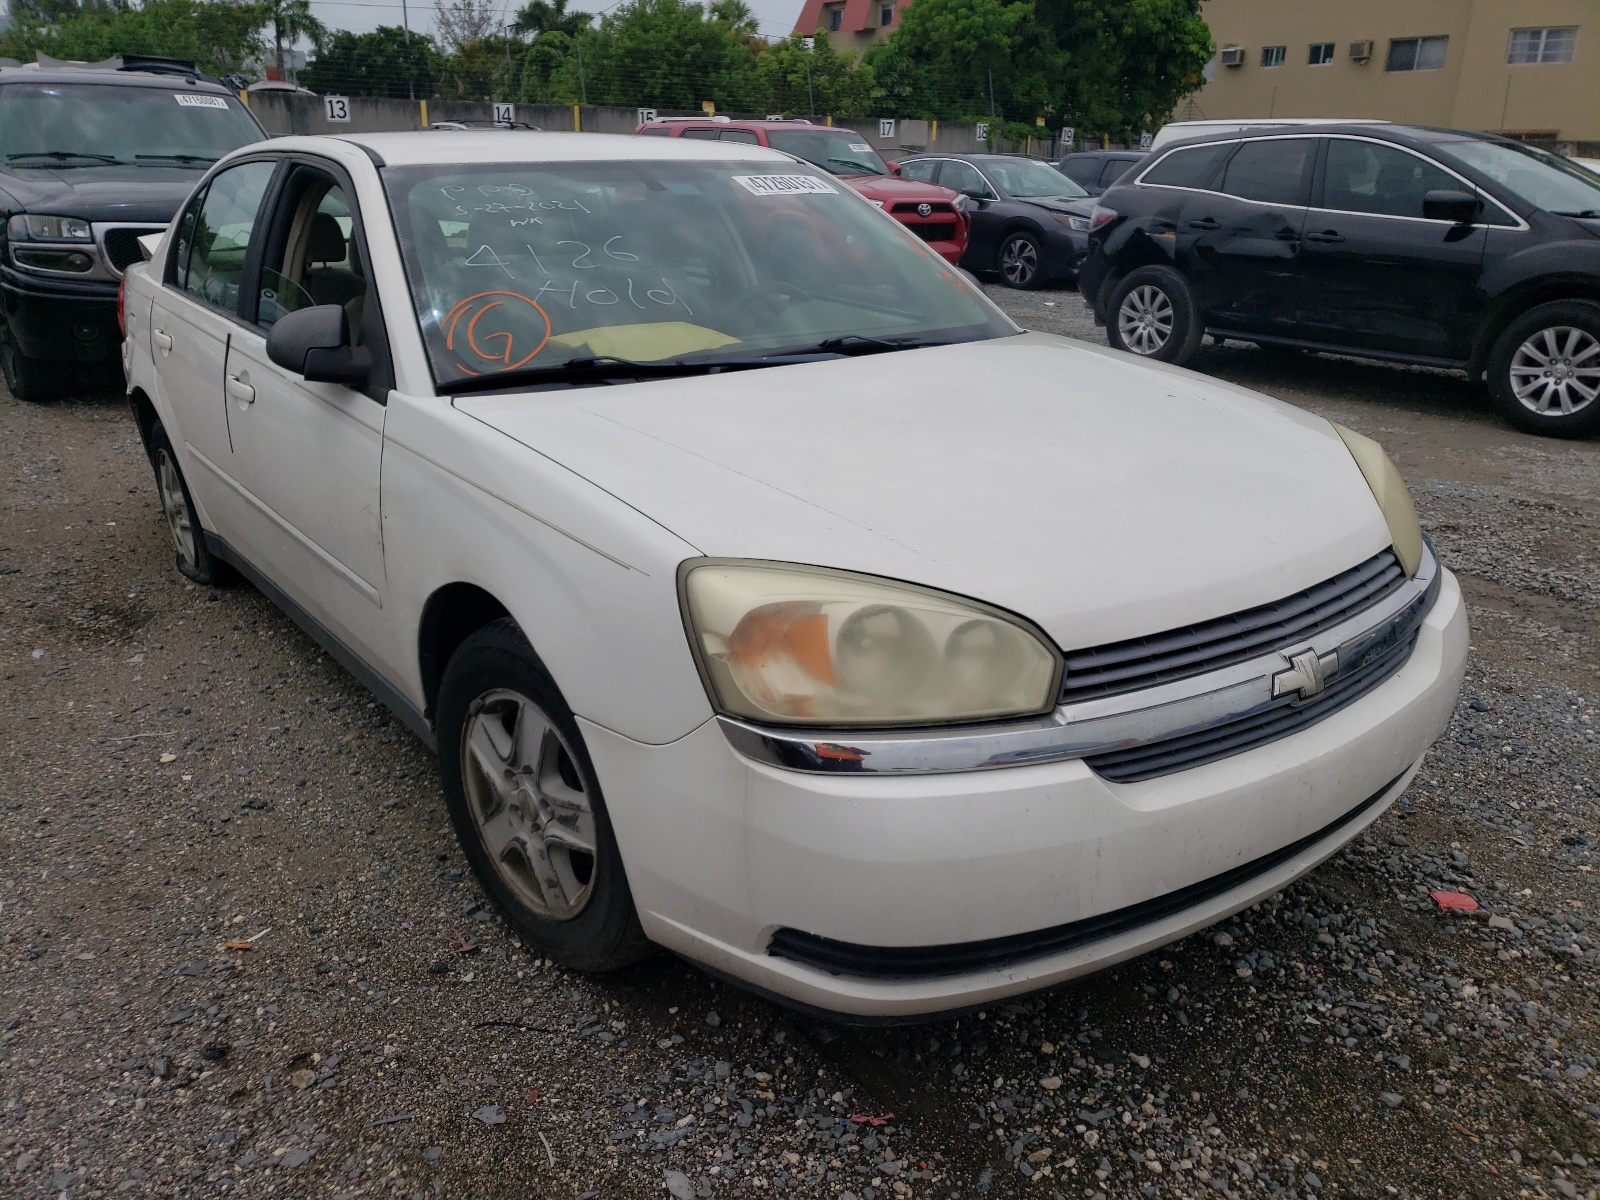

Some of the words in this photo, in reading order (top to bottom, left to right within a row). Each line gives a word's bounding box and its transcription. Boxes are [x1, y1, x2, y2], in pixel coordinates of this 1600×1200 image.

[329, 100, 347, 119] 13
[495, 105, 511, 123] 14
[881, 121, 893, 136] 17
[977, 124, 988, 139] 18
[1063, 129, 1072, 143] 19
[1140, 135, 1151, 148] 20
[465, 236, 640, 280] 4126
